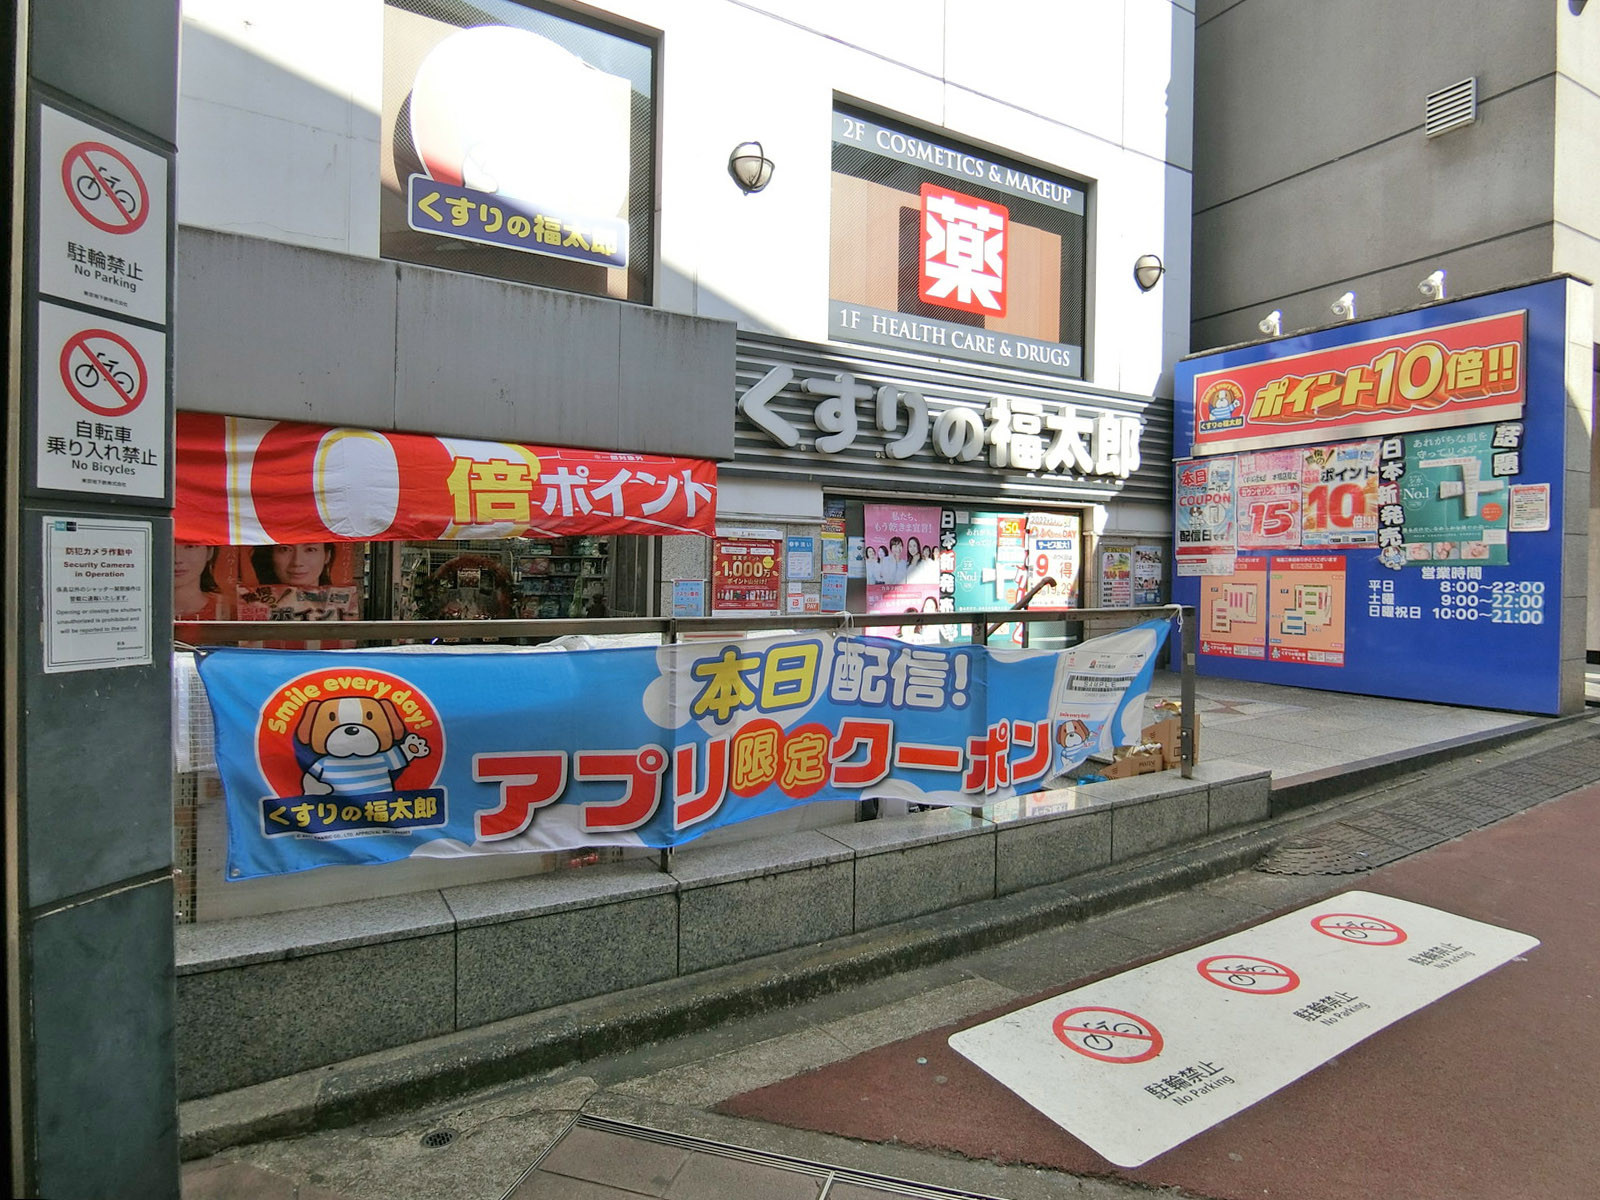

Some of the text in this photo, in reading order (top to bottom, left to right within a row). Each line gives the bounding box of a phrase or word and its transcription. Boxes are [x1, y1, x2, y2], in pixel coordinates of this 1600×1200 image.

[843, 118, 1072, 204] 2F COSMETICS & MAKEUP
[67, 241, 144, 281] 駐輪禁止
[925, 194, 1004, 311] 薬
[74, 264, 137, 293] No Parking
[840, 308, 1071, 367] 1F HEALTH CARE & DRUGS
[76, 420, 132, 443] 自転車
[738, 363, 1144, 478] くすりの福太郎
[47, 436, 158, 466] 乗り入れ禁止
[72, 460, 136, 475] No Bicycles
[1182, 469, 1208, 488] 本日
[1321, 466, 1377, 483] ポイント
[1180, 492, 1231, 506] COUPON
[1308, 483, 1366, 529] 10
[1250, 501, 1294, 537] 15
[65, 547, 133, 557] 防犯カメラ作動中
[85, 571, 125, 579] Operation
[1368, 580, 1394, 592] 平日
[1421, 566, 1482, 580] 営業時間
[1368, 593, 1394, 605] 土曜
[1368, 605, 1422, 619] 日曜祝日
[268, 676, 433, 734] Smile every day!
[269, 797, 437, 827] くすりの福太郎
[1408, 942, 1463, 966] 駐輪禁止
[1293, 991, 1359, 1022] 駐輪禁止
[1320, 1001, 1371, 1026] No Parking
[1143, 1060, 1225, 1100] 駐輪禁止
[1172, 1075, 1236, 1106] No Parking
